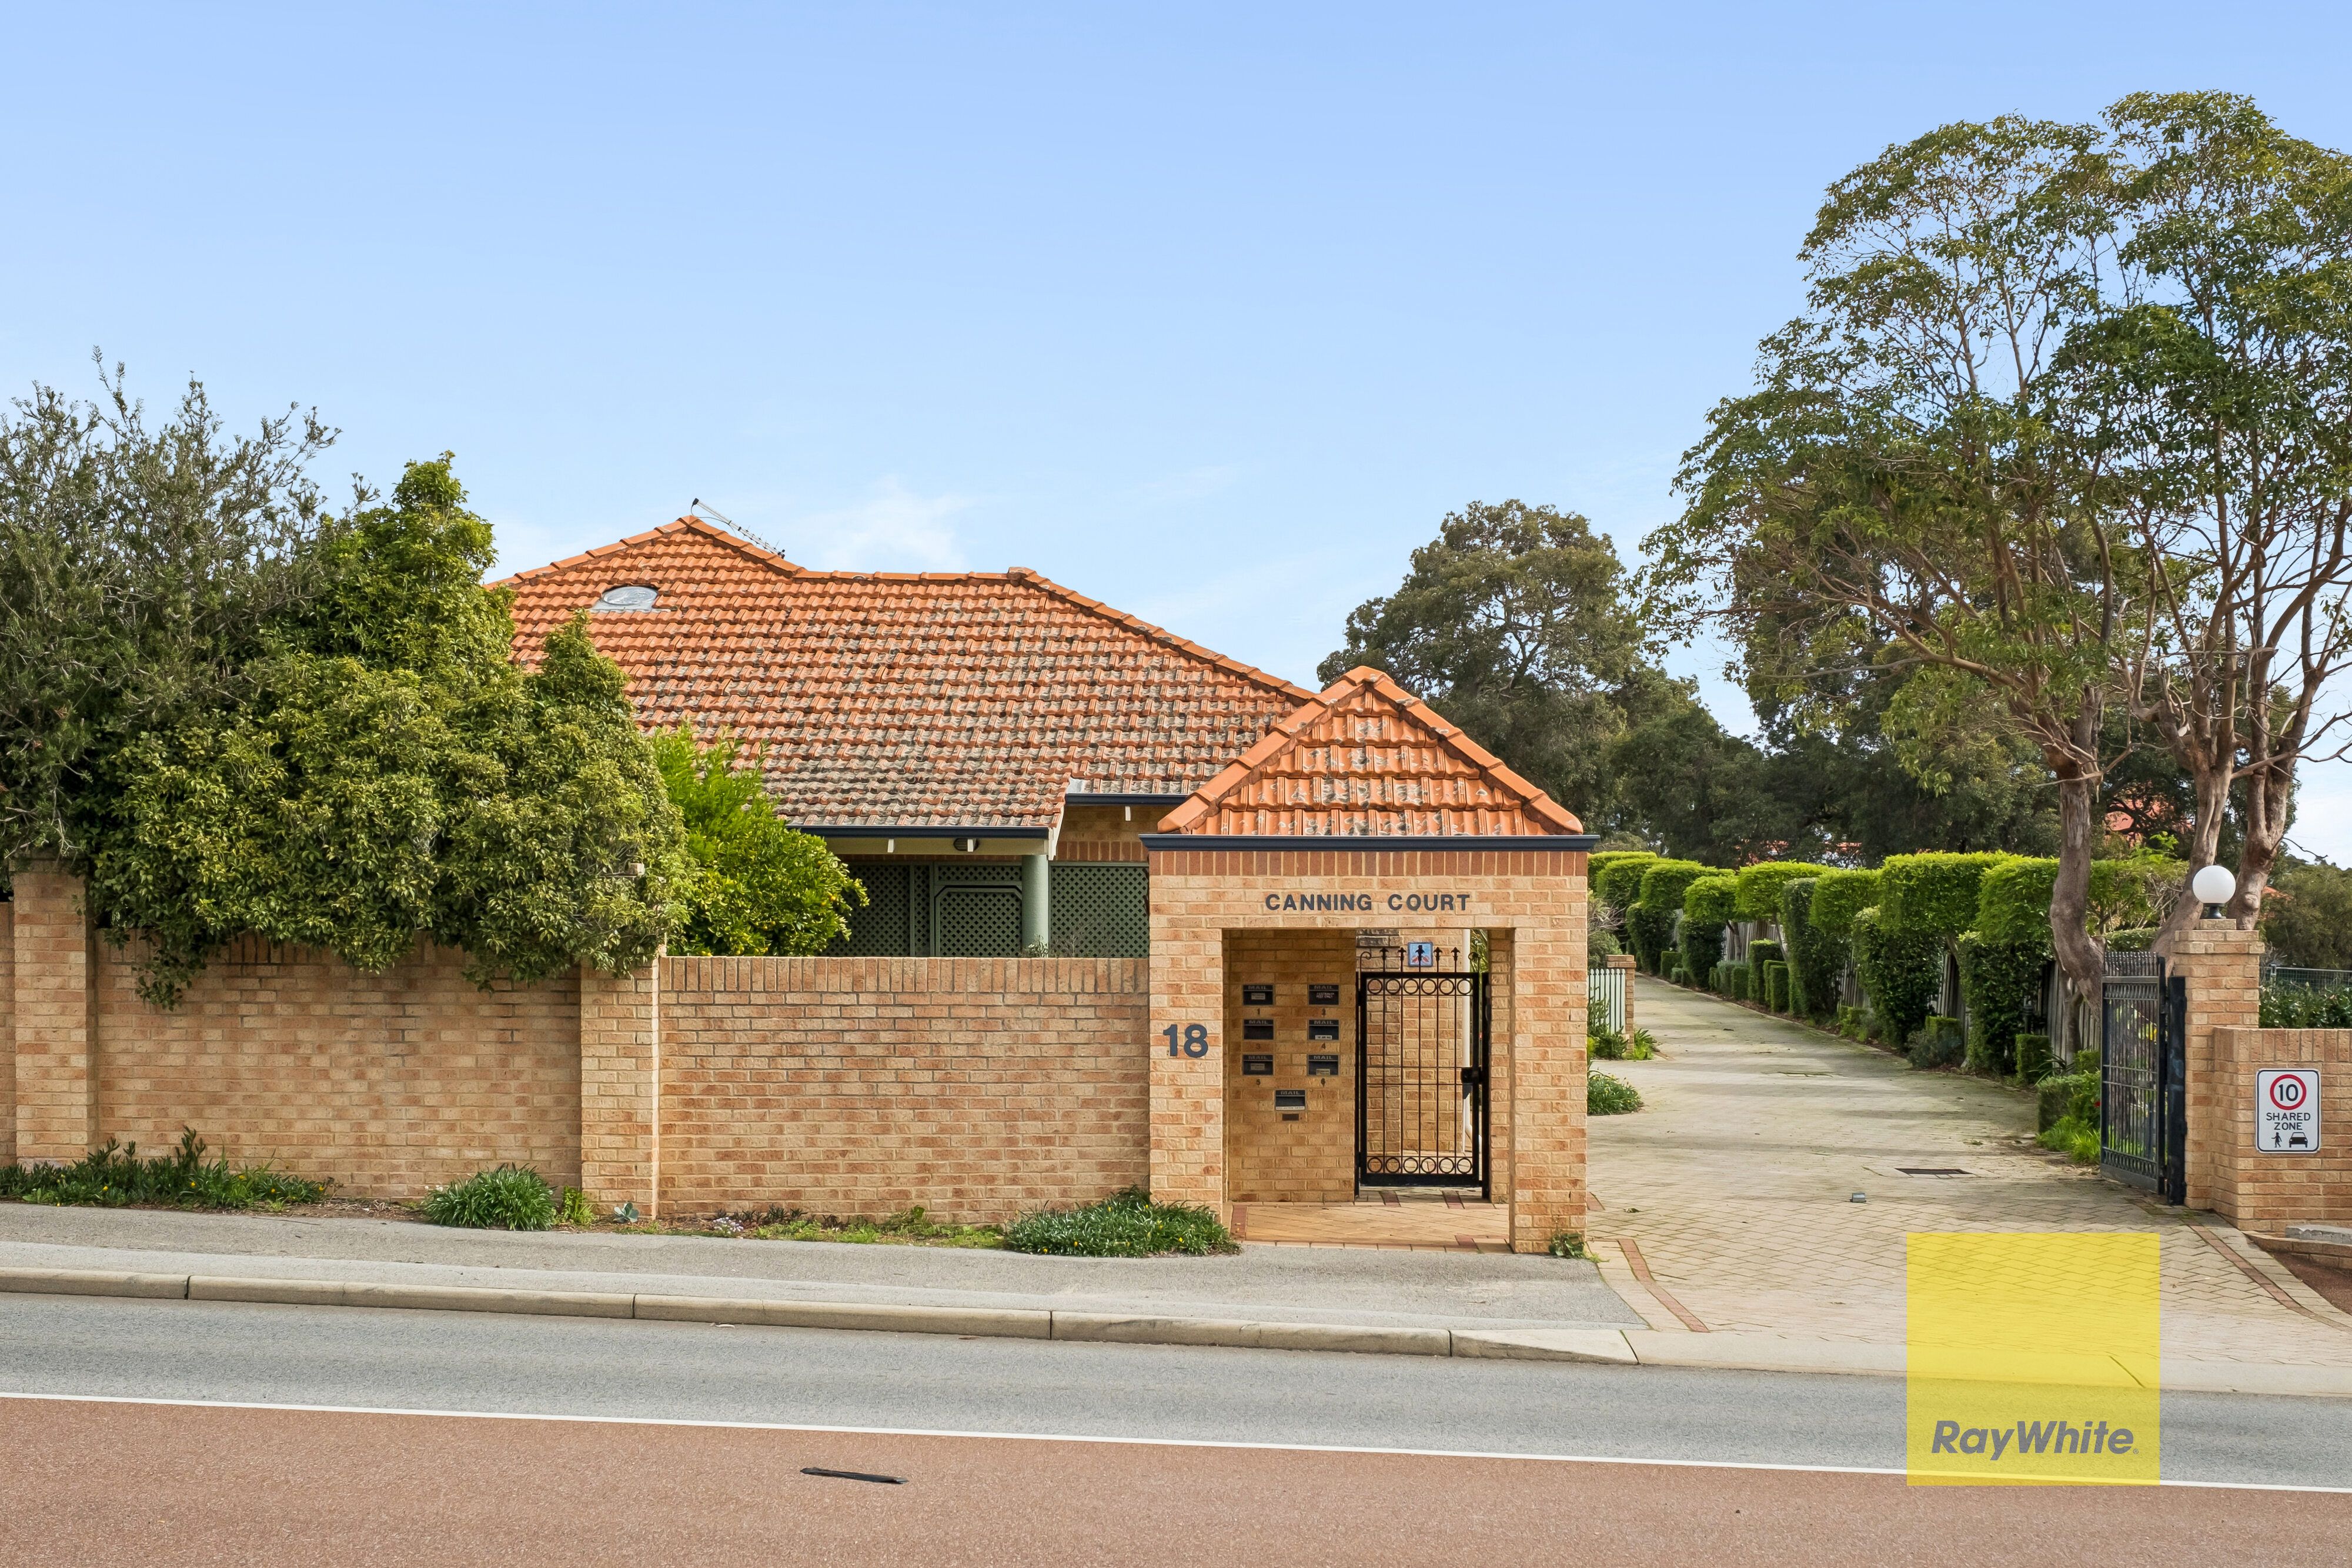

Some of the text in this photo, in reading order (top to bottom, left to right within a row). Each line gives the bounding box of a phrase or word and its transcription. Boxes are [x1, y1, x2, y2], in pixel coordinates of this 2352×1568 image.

[1265, 894, 1471, 911] CANNING COURT
[1163, 1024, 1208, 1058] 18
[2278, 1084, 2298, 1102] 10
[2266, 1112, 2311, 1121] SHARED
[2274, 1122, 2303, 1131] ZONE
